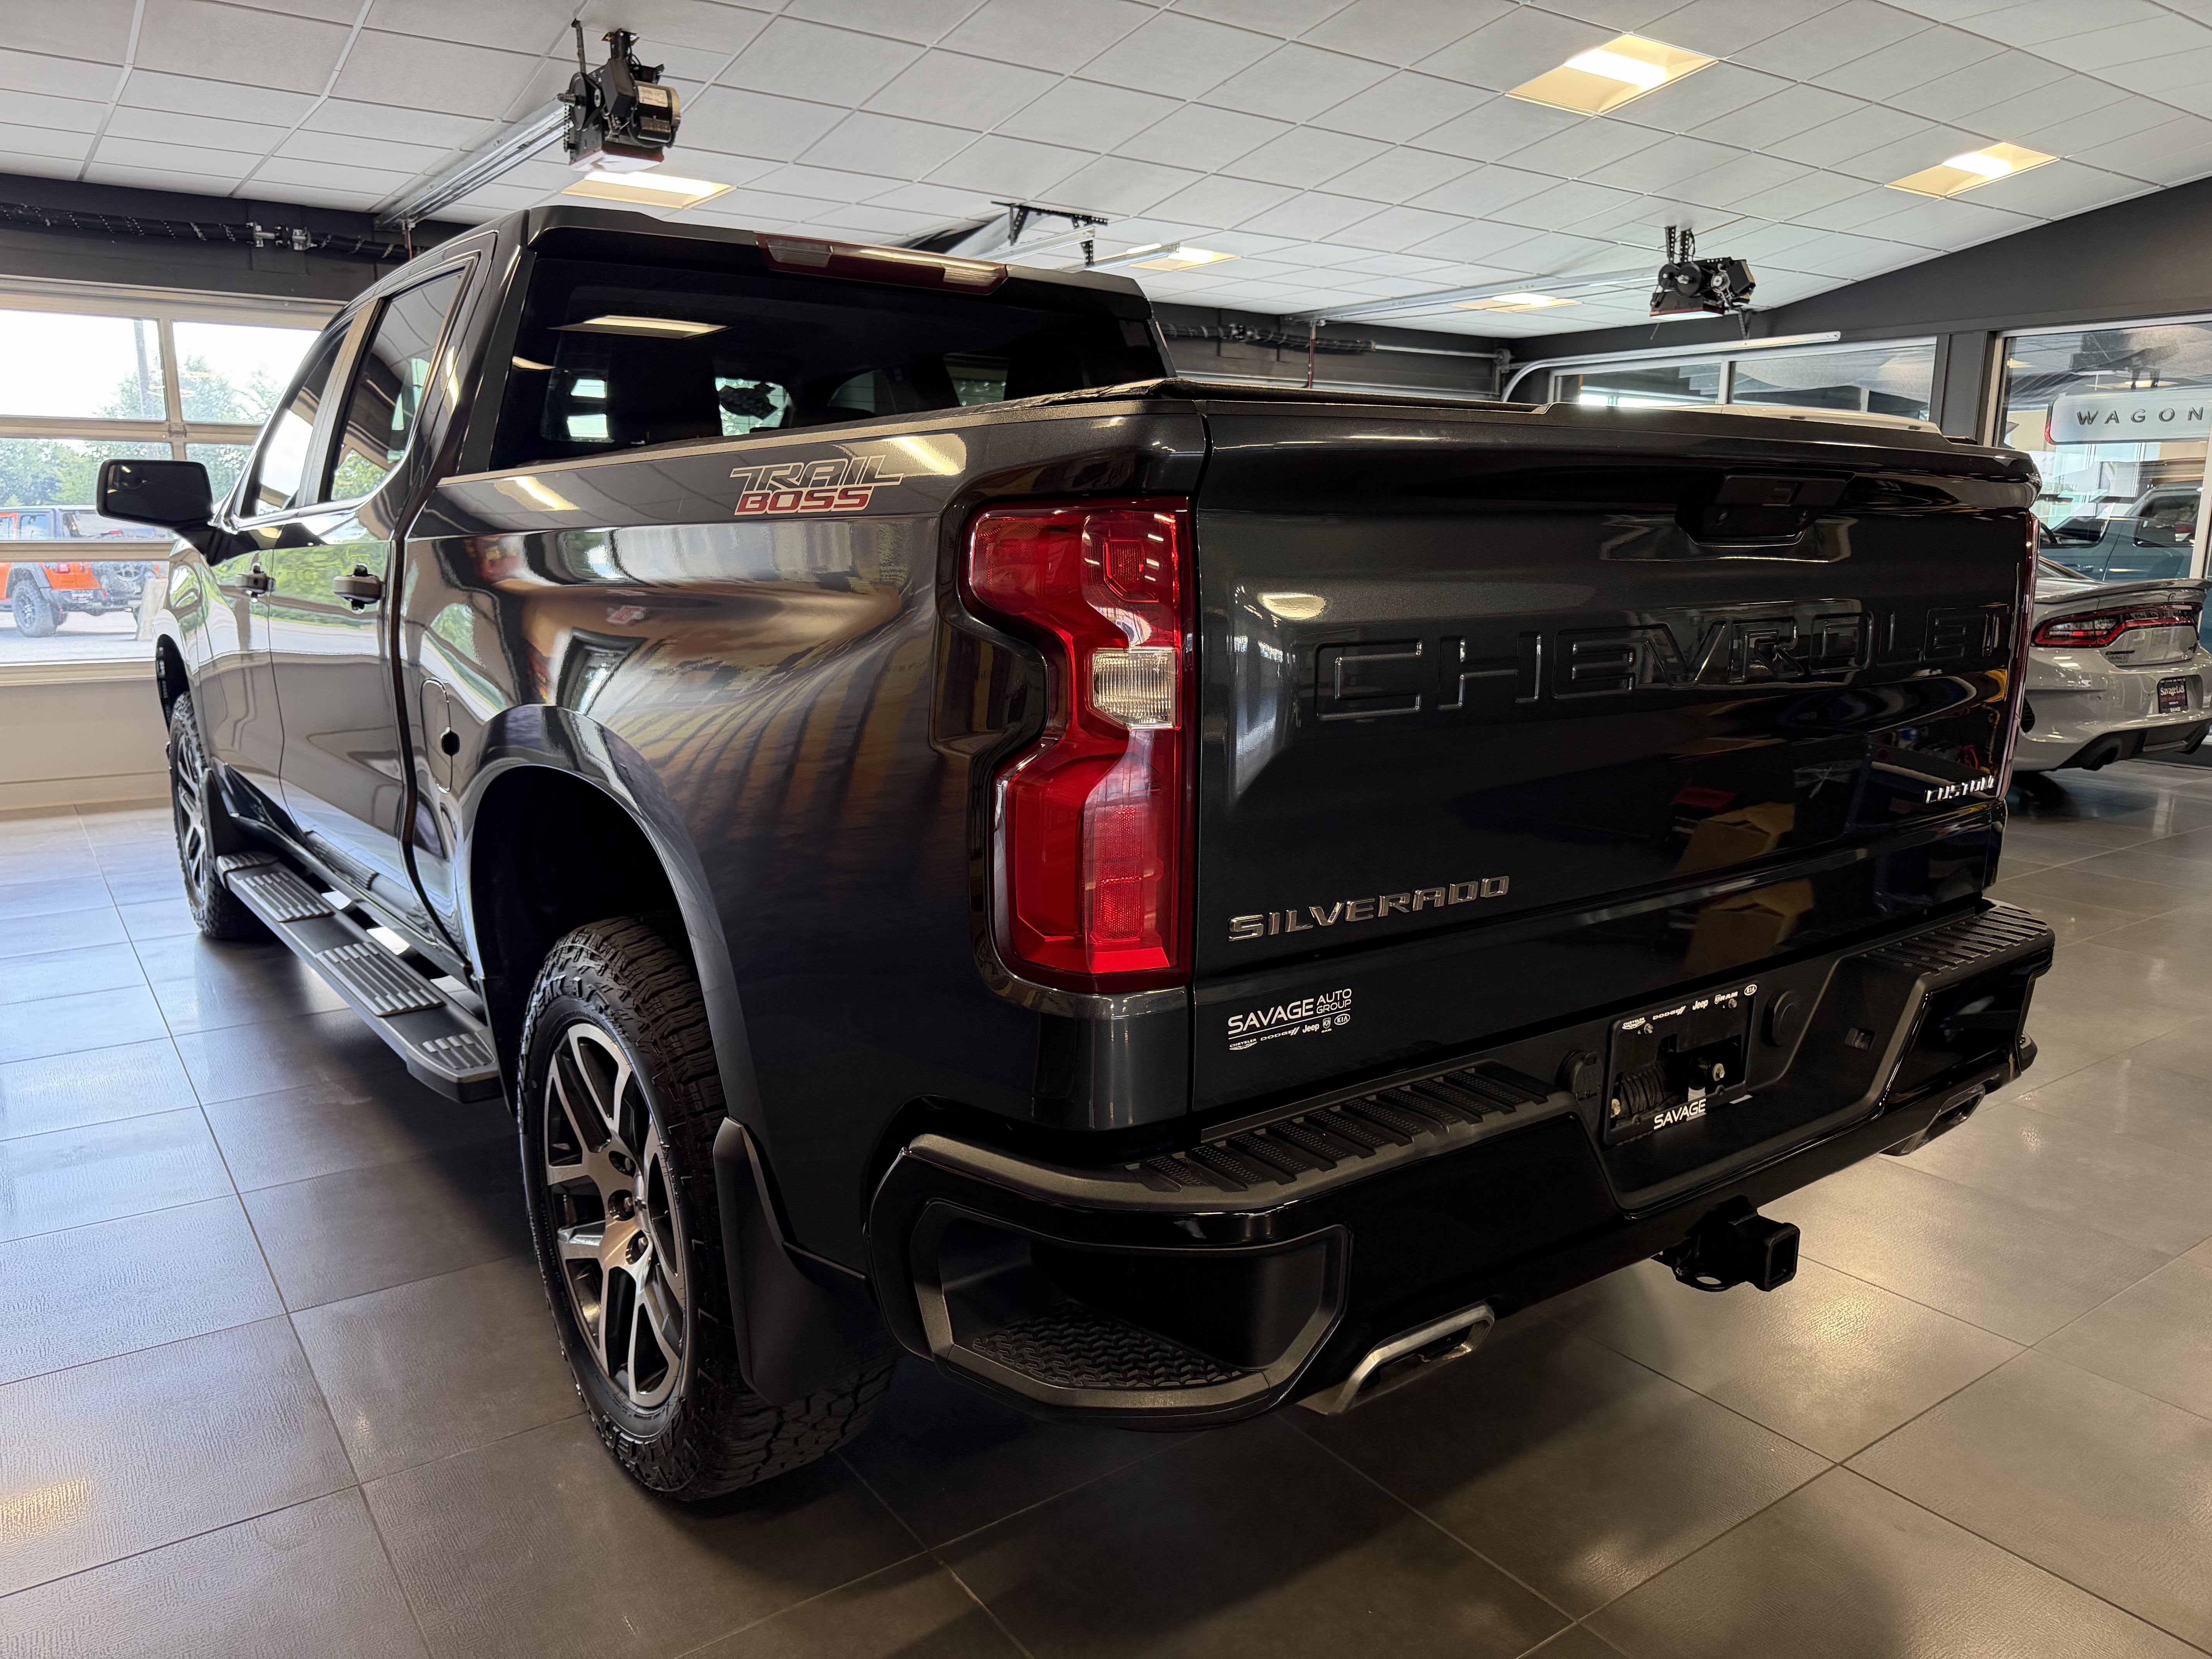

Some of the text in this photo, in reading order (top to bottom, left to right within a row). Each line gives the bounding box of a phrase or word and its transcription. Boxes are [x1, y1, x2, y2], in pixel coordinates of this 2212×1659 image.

[2076, 407, 2204, 425] WAGON
[730, 455, 904, 491] TRAIL
[734, 486, 874, 515] BOSS
[1315, 603, 2011, 721] CHEVROLET
[1228, 876, 1509, 942] SILVERADO
[1316, 999, 1352, 1014] GROUP
[1317, 988, 1352, 1006] AUTO
[1692, 999, 1708, 1010] Jeep
[1228, 998, 1314, 1035] SAVAGE
[1229, 1038, 1257, 1048] CHRYSLER
[1261, 1029, 1296, 1041] DODGE
[1302, 1022, 1320, 1033] Jeep
[1654, 1098, 1706, 1130] SAVAGE
